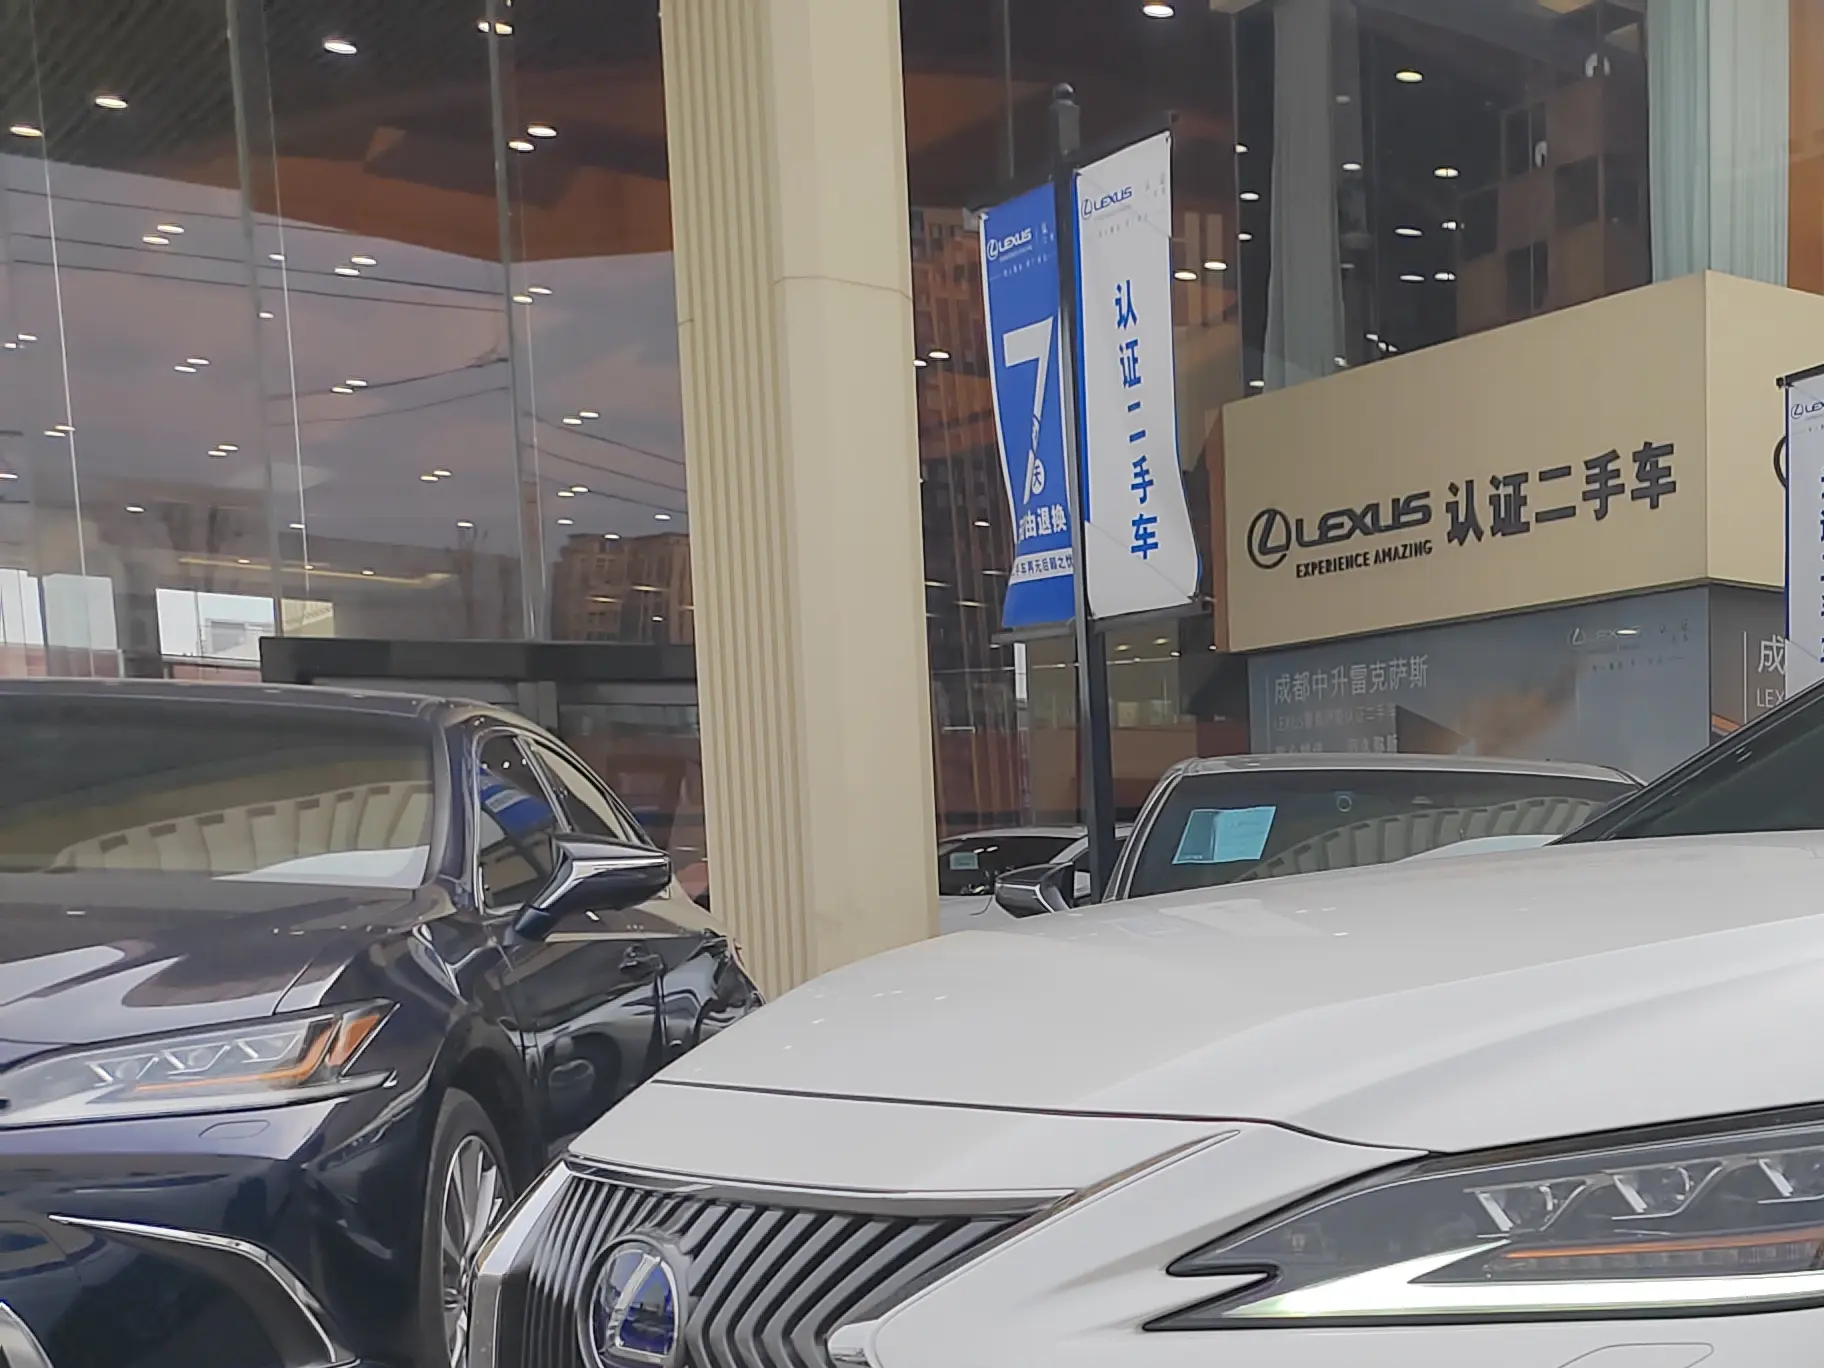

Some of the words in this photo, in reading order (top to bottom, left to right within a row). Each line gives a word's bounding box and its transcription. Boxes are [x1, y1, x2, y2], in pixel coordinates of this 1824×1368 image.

[1093, 186, 1133, 212] LEXUS
[998, 227, 1033, 252] LEXUS
[1003, 316, 1054, 505] 7
[1114, 279, 1159, 560] 认证二手车
[1295, 491, 1432, 547] LEXUS
[1445, 441, 1677, 546] 认证二手车
[1296, 551, 1370, 578] EXPERIENCE
[1373, 540, 1433, 565] AMAZING
[1274, 654, 1429, 704] 成都中升雷克萨斯
